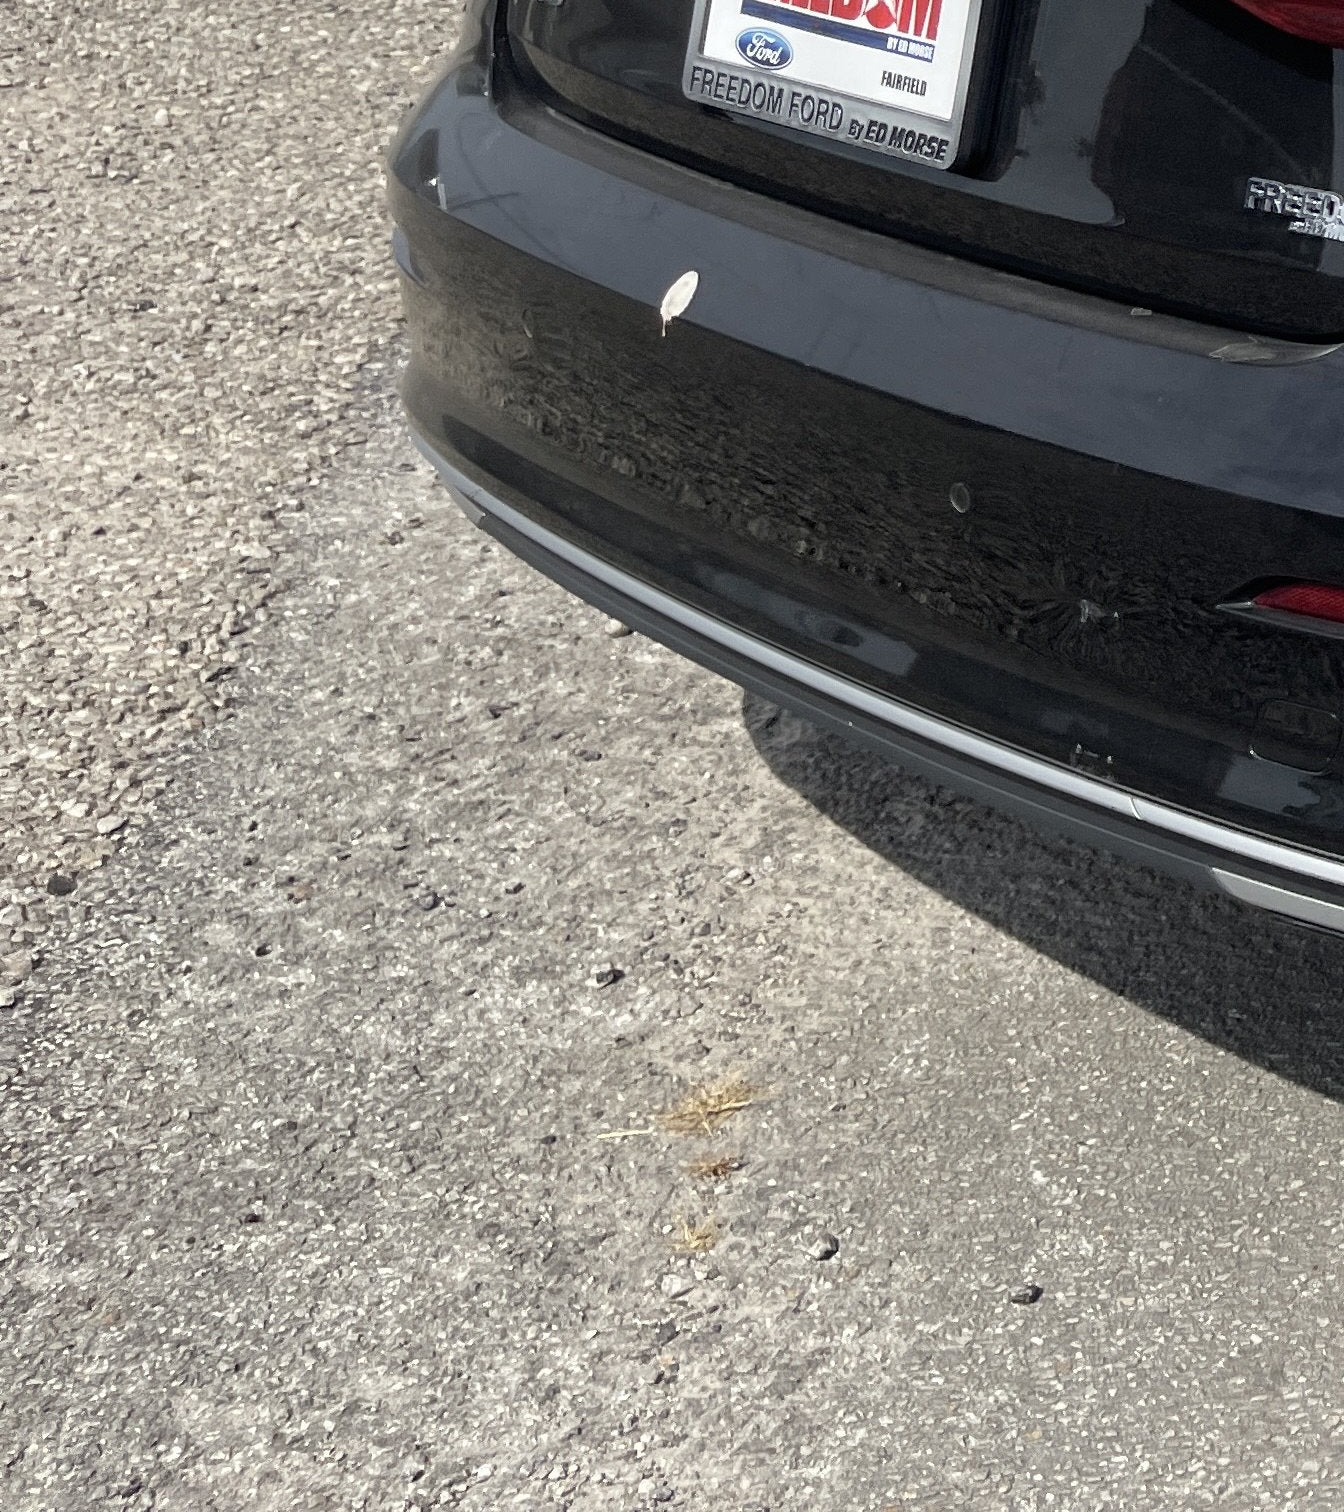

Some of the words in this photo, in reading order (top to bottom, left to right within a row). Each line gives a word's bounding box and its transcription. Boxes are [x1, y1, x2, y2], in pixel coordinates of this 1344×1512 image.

[745, 32, 782, 65] Ford
[881, 70, 928, 97] FAIRFIELD
[690, 65, 786, 116] FREEDOM
[788, 93, 844, 132] FORD
[864, 119, 888, 144] ED
[889, 125, 950, 163] MORSE
